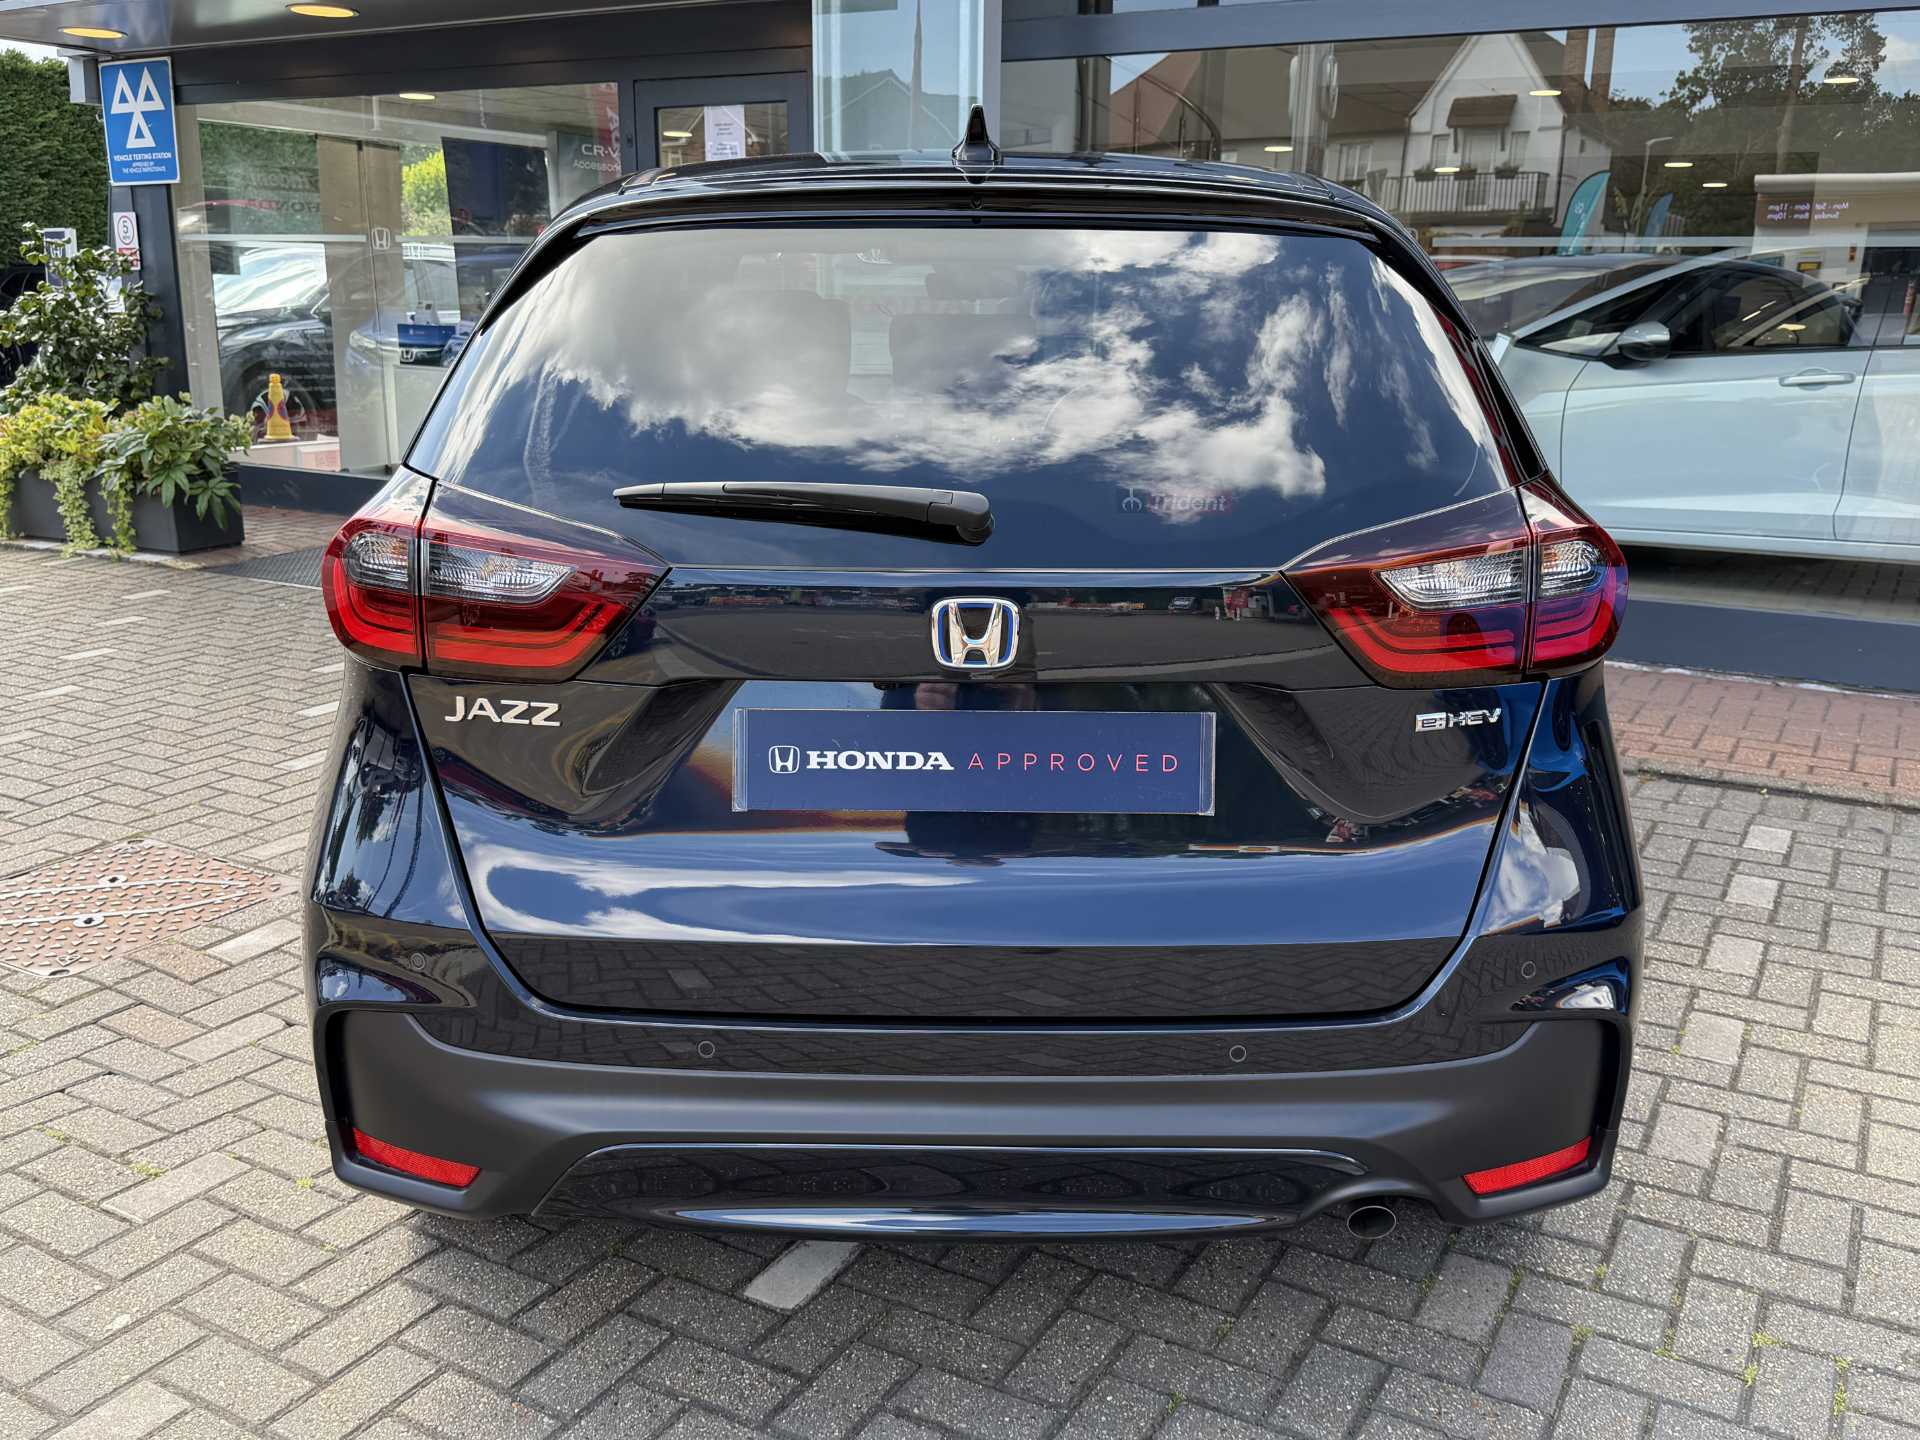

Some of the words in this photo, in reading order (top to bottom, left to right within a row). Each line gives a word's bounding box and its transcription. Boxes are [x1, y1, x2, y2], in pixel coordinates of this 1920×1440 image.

[122, 220, 129, 234] 5
[1150, 494, 1226, 512] Trident
[444, 696, 561, 727] JAZZ
[806, 750, 954, 771] HONDA
[967, 752, 1178, 773] APPROVED
